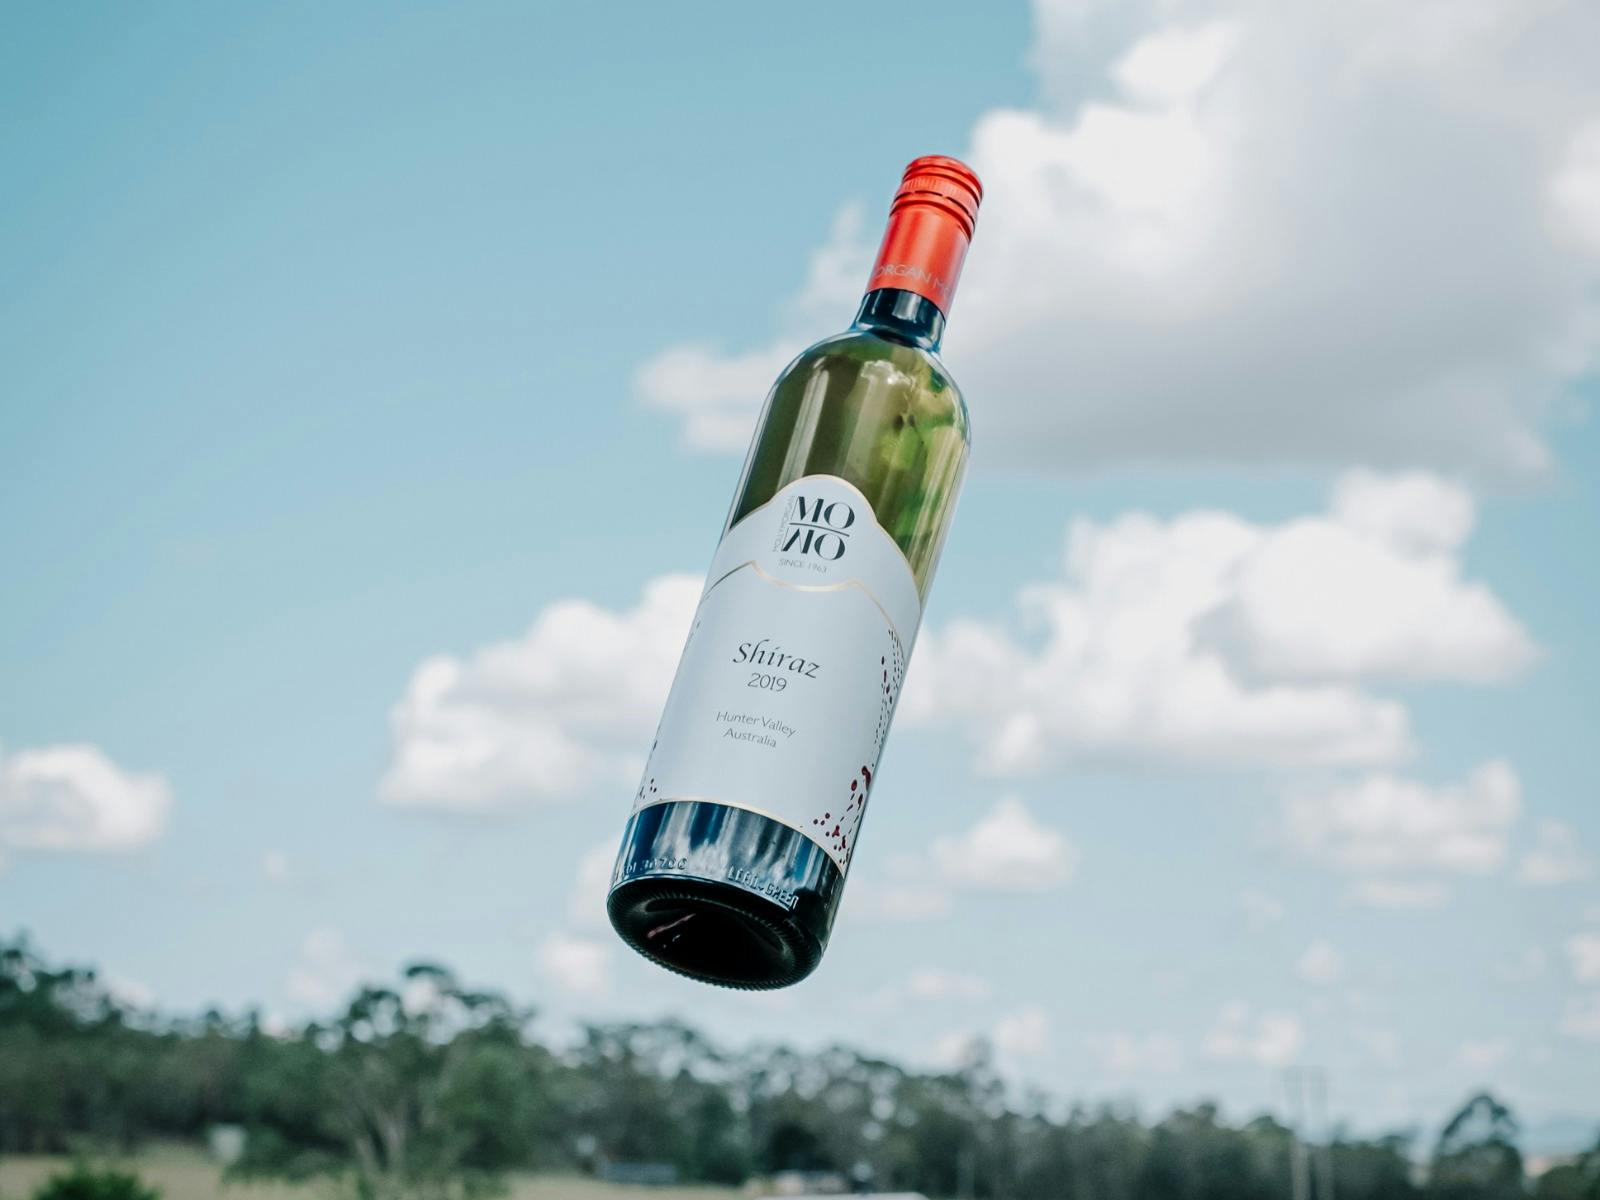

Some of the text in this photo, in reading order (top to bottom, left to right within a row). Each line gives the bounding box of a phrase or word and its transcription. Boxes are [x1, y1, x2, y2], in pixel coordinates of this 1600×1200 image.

[788, 496, 855, 529] MO
[778, 559, 803, 569] SINCE
[732, 639, 820, 679] Shiraz
[747, 672, 787, 692] 2019
[716, 711, 796, 738] Hunter Valley
[724, 728, 777, 748] Australia
